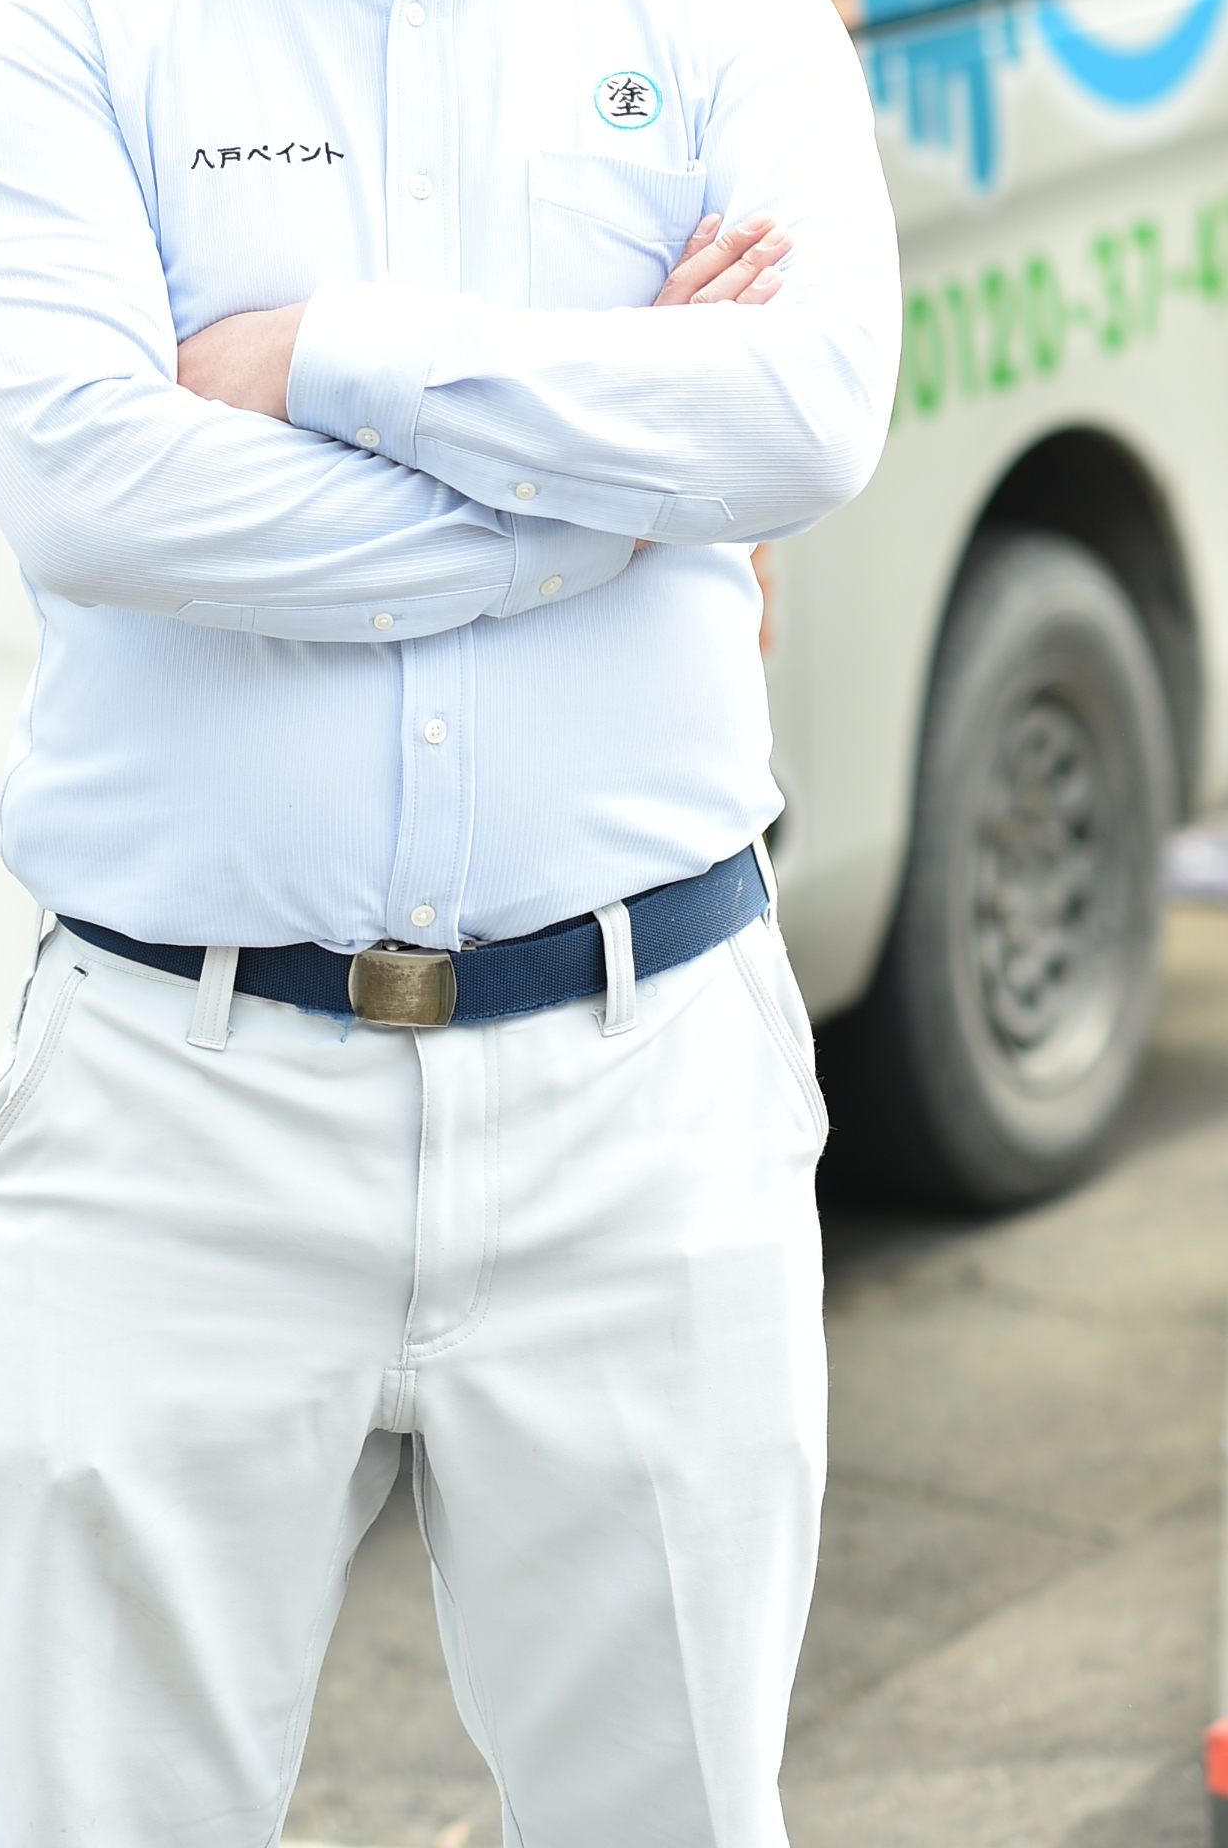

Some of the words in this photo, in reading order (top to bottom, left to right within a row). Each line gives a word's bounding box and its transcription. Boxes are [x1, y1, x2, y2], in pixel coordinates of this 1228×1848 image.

[606, 77, 650, 117] 塗
[190, 141, 345, 170] 八戸ペイント
